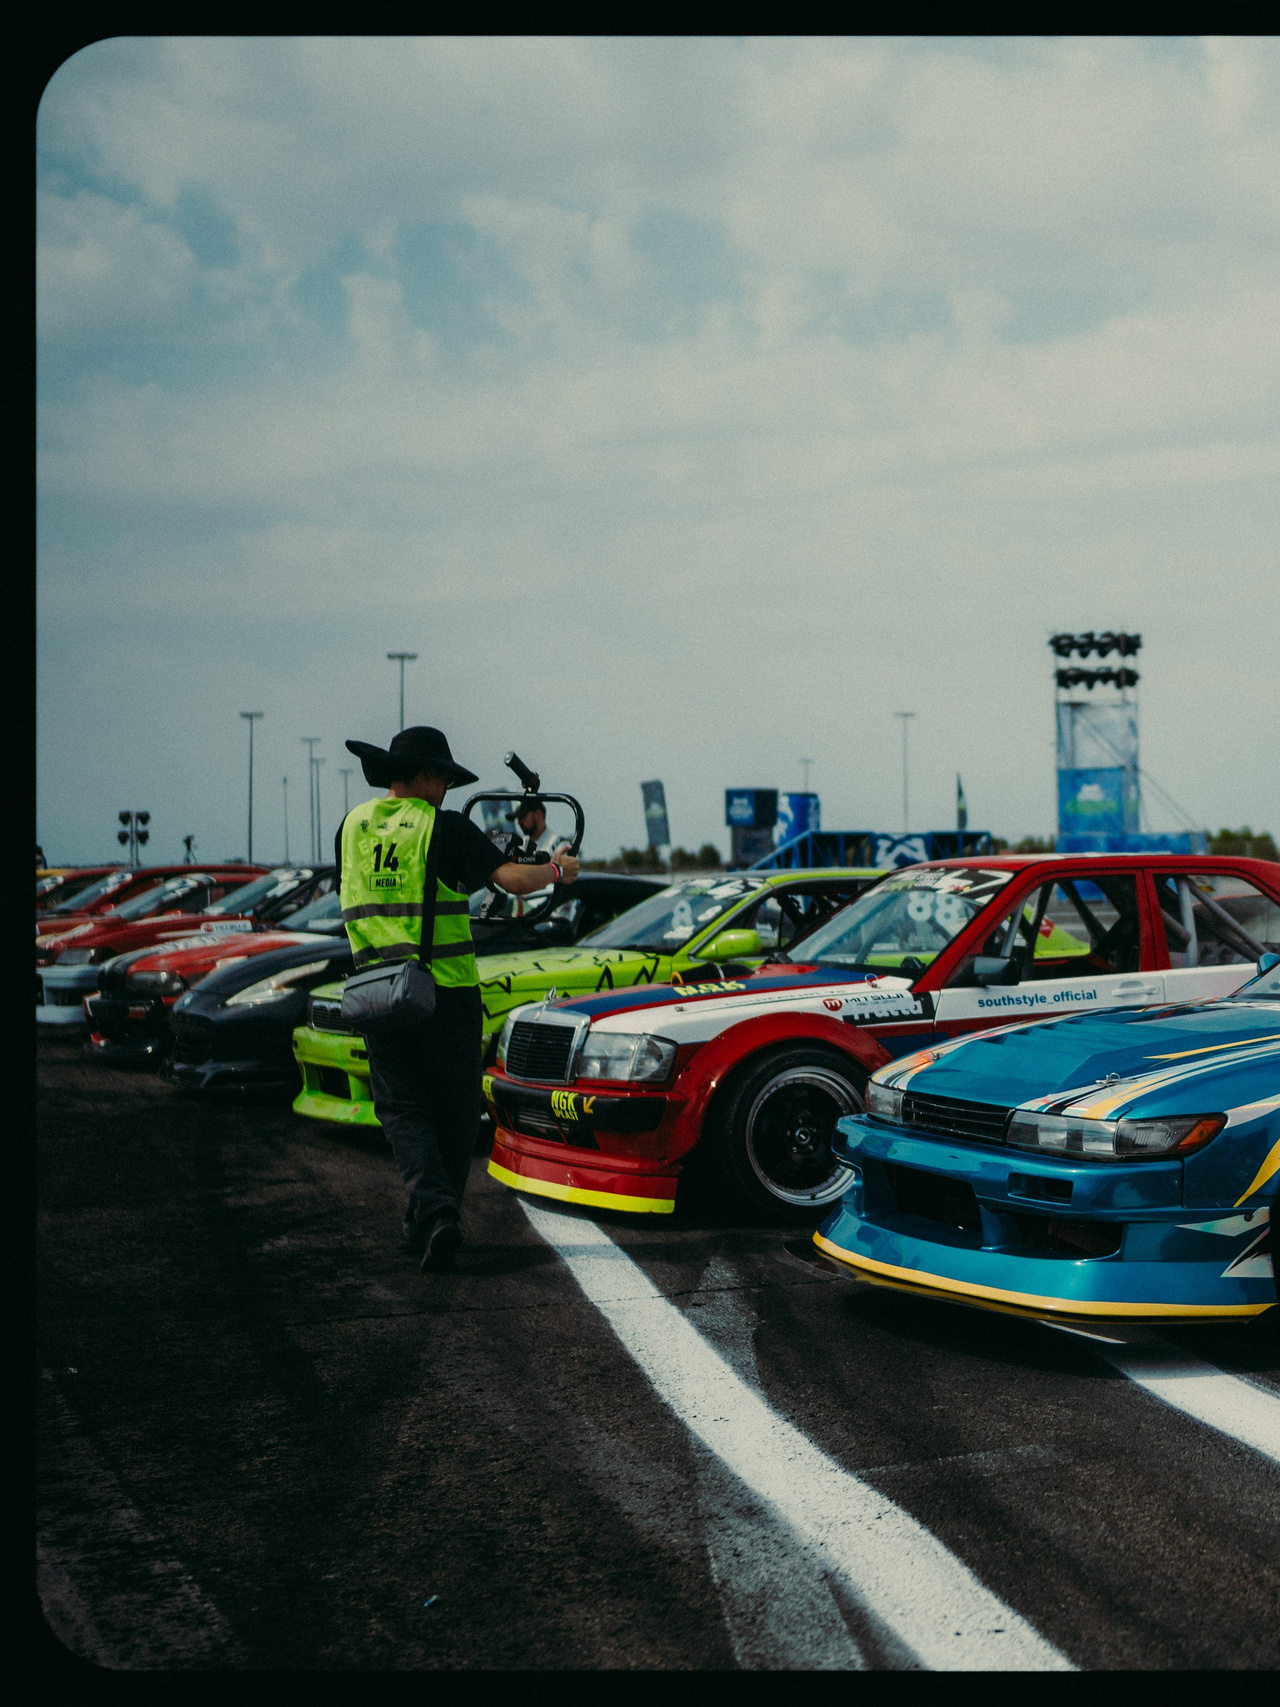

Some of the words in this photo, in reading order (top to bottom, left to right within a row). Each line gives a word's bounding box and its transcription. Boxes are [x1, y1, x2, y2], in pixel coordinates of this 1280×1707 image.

[373, 843, 399, 872] 14
[375, 878, 397, 888] MEDIA
[844, 993, 905, 1004] MITSUJI
[977, 989, 1098, 1008] southstyle_official
[551, 1090, 578, 1112] NGK
